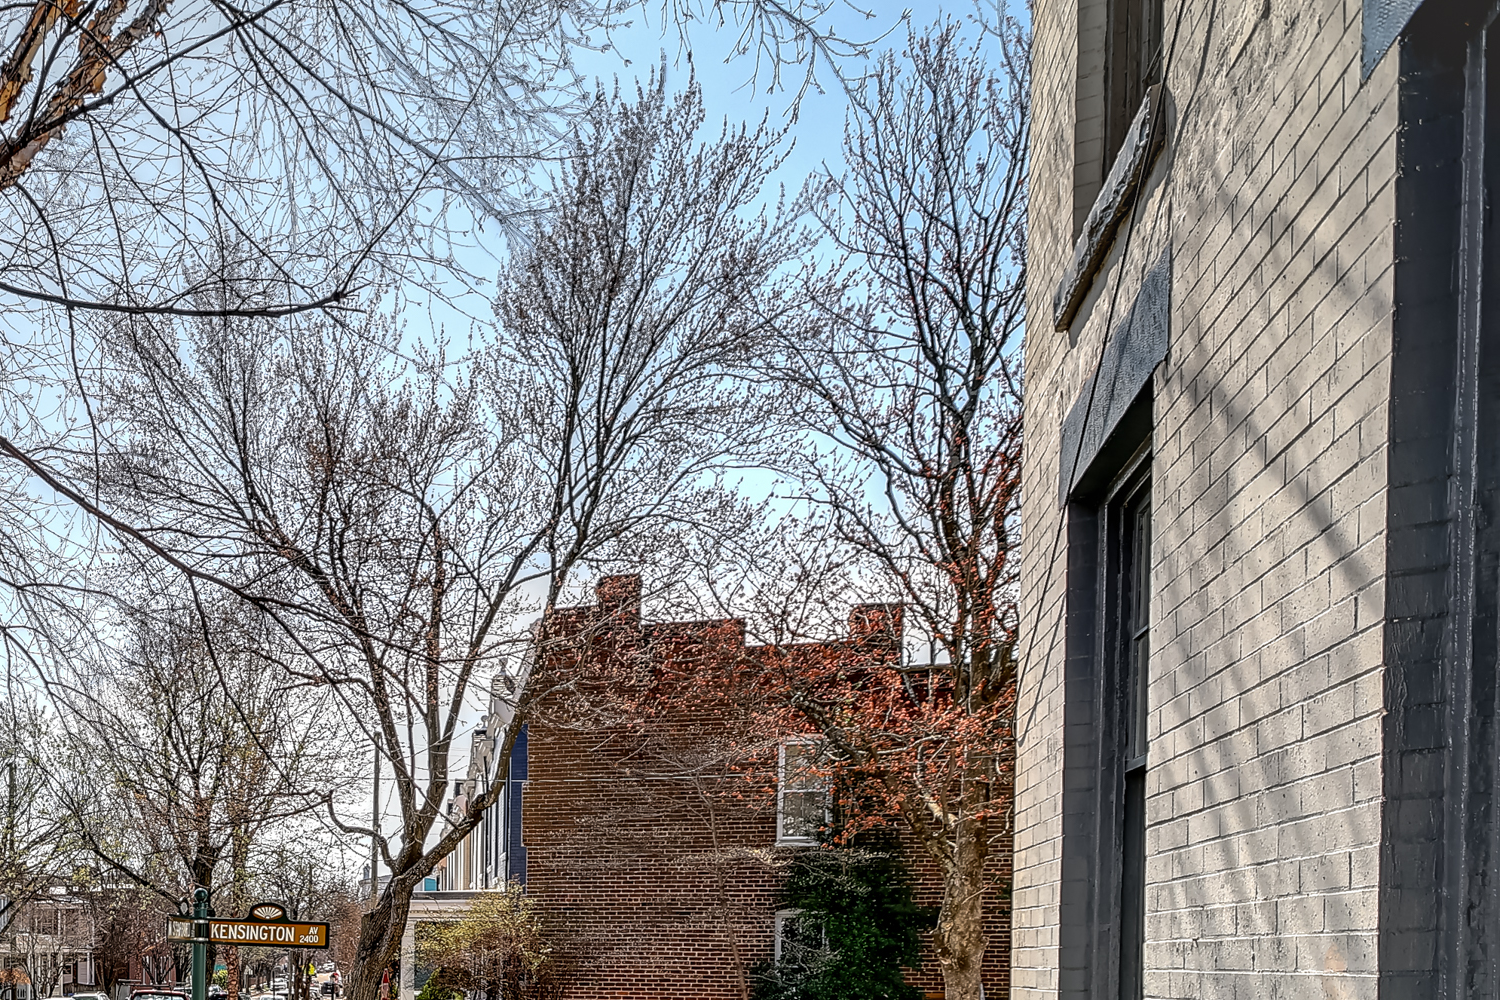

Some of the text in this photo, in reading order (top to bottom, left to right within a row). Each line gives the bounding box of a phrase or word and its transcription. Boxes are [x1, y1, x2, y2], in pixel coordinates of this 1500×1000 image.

[210, 923, 295, 942] KENSINGTON
[308, 926, 319, 935] AV
[299, 935, 319, 943] 2400
